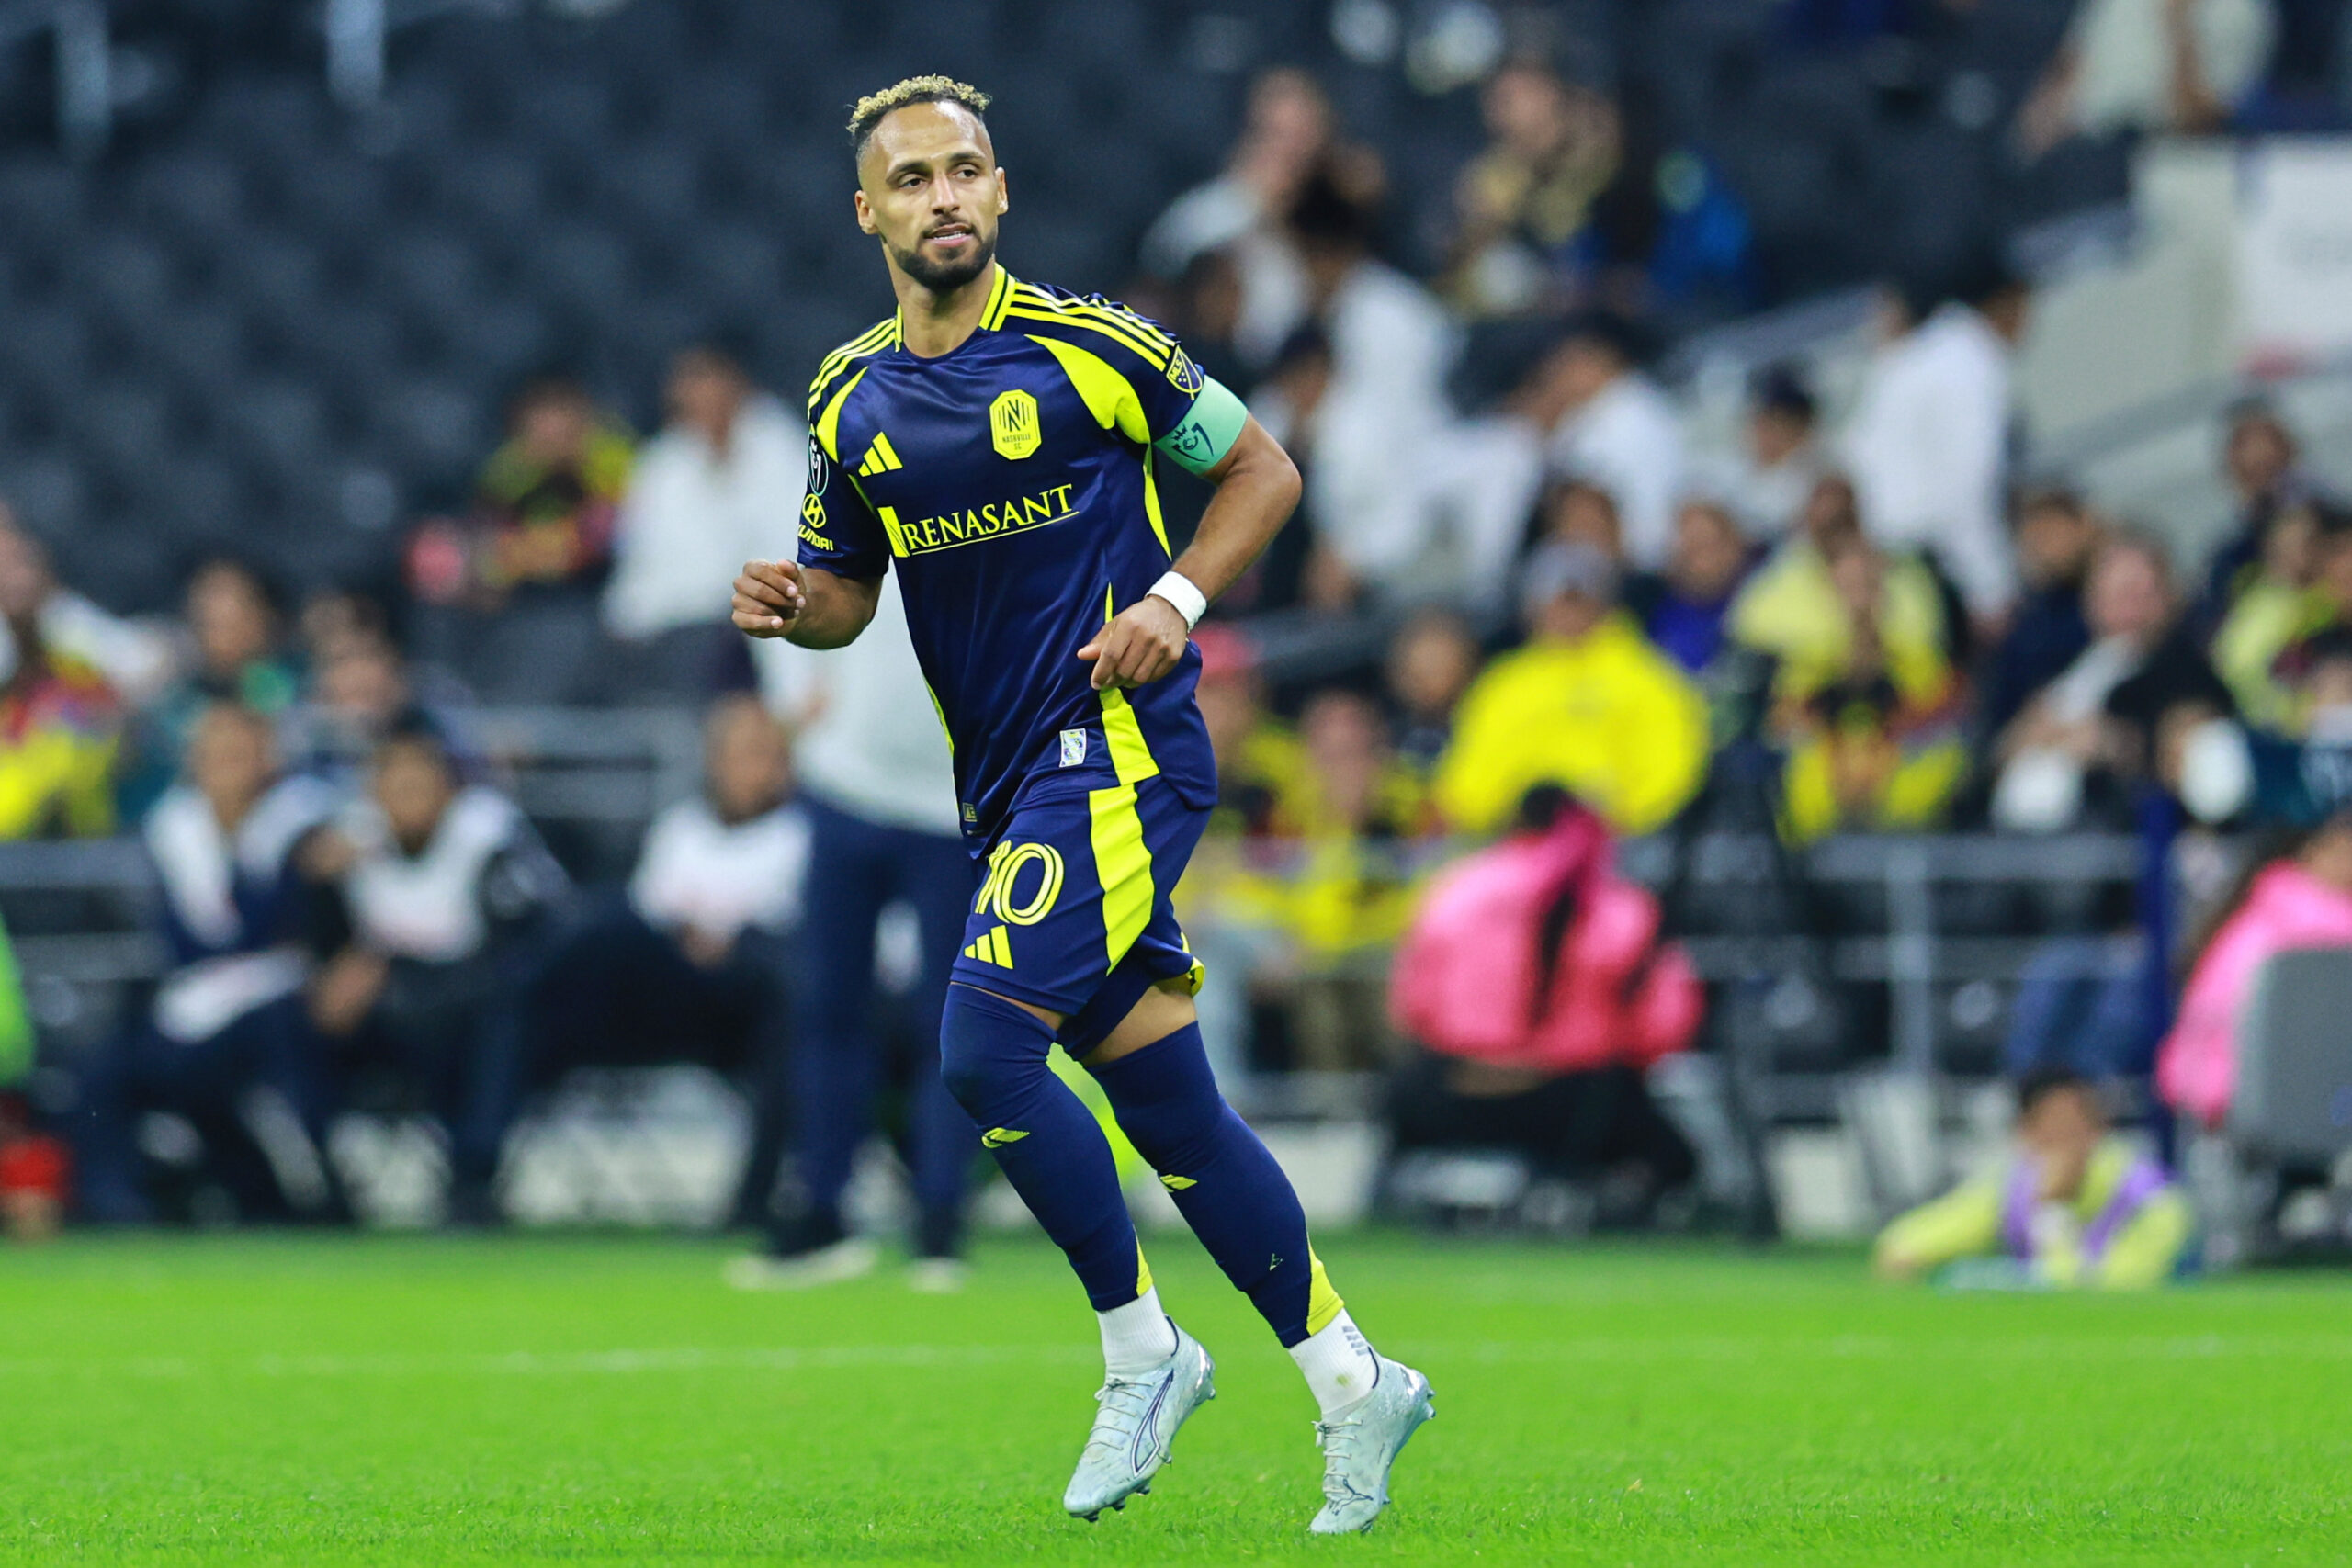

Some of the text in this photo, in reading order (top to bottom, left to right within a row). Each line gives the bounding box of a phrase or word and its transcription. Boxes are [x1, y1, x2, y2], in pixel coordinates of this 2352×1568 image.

[798, 524, 834, 551] UNDAI
[901, 483, 1072, 551] RENASANT
[975, 840, 1064, 925] 10
